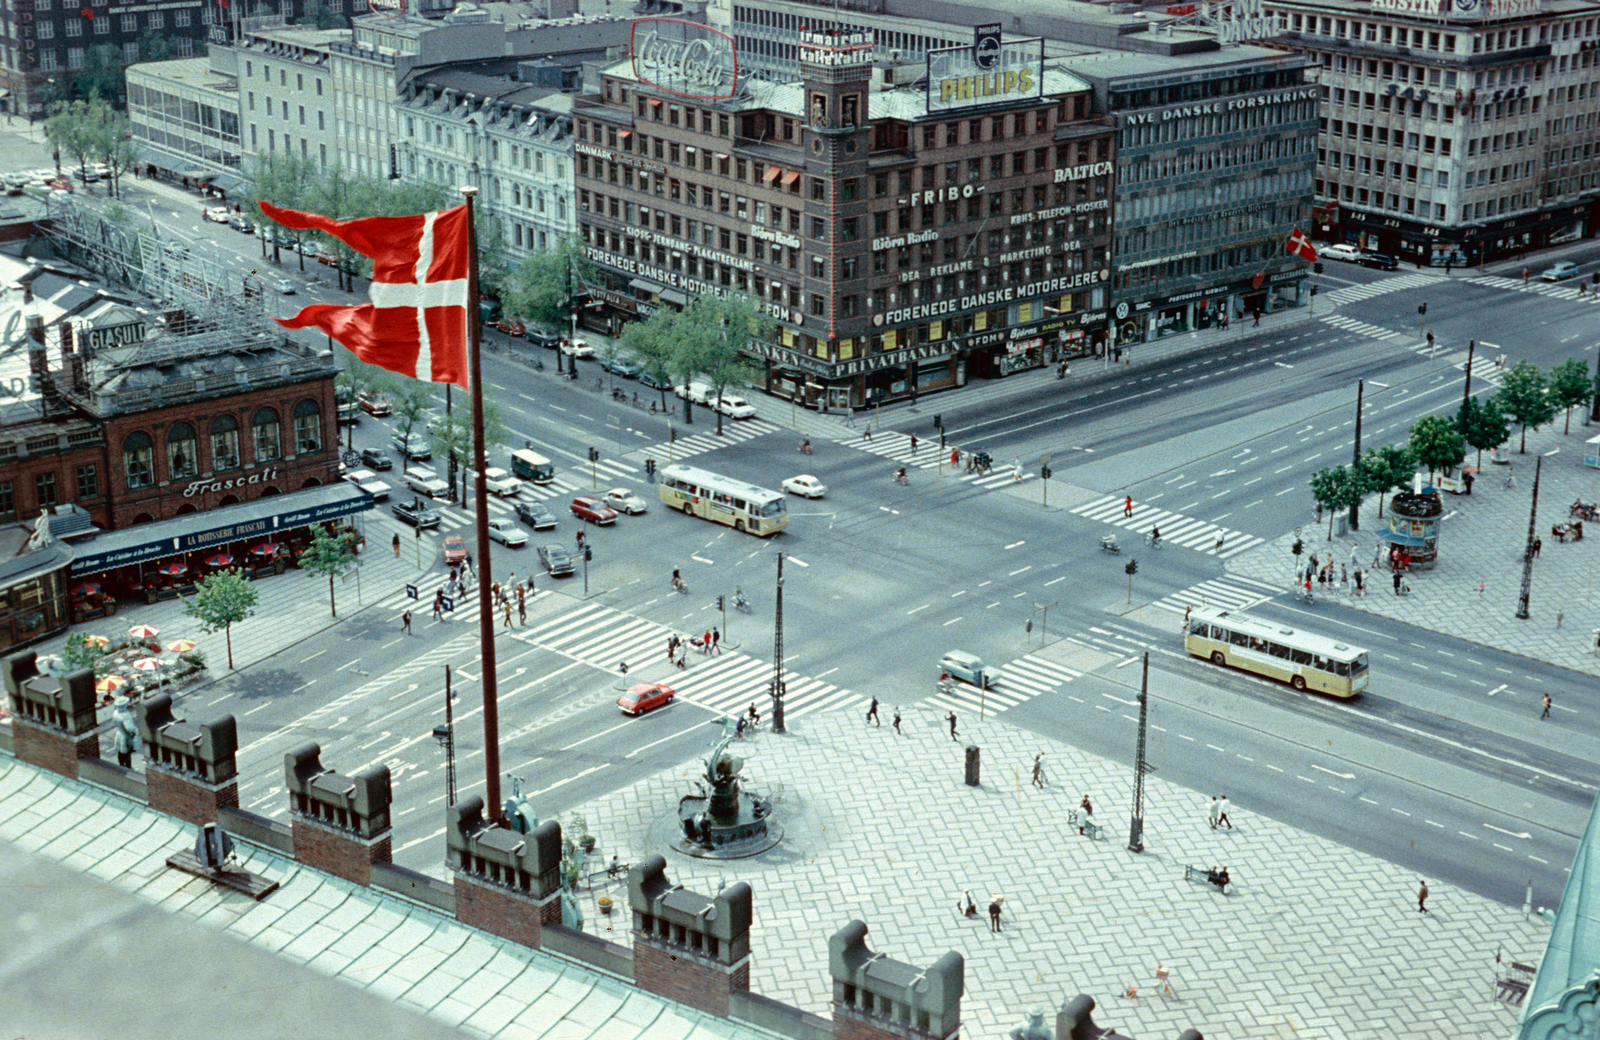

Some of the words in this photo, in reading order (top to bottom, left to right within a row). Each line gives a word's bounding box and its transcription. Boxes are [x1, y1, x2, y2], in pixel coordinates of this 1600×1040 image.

[1372, 0, 1439, 15] AUSTIN
[978, 26, 1000, 35] PHILIPS
[940, 69, 1033, 102] PHILIPS
[1385, 83, 1431, 101] SAS
[1491, 86, 1528, 102] SAS
[1126, 112, 1155, 125] NYE
[1162, 103, 1221, 120] DANSKE
[1228, 89, 1317, 110] FORSIKRING
[575, 143, 612, 160] DANMARK
[1054, 161, 1114, 183] BALTICA
[911, 184, 974, 207] FRIBO
[776, 231, 801, 249] Radio
[907, 229, 939, 245] Radio
[1423, 226, 1440, 237] SAS
[587, 247, 636, 272] FORENEDE
[638, 263, 677, 286] DANSKE
[930, 260, 974, 277] REKLAME
[1000, 245, 1052, 263] MARKETING
[886, 299, 957, 325] FORENEDE
[961, 287, 1013, 309] DANSKE
[1017, 270, 1099, 298] MOTOREJERE
[89, 322, 147, 350] GLASULD
[1041, 321, 1064, 331] RADIO
[1065, 319, 1076, 327] TV
[975, 334, 997, 345] FDM
[836, 340, 960, 376] PRIVATBANKEN
[183, 466, 278, 498] Frascati
[187, 536, 196, 546] LA
[236, 521, 266, 534] FRASCATI
